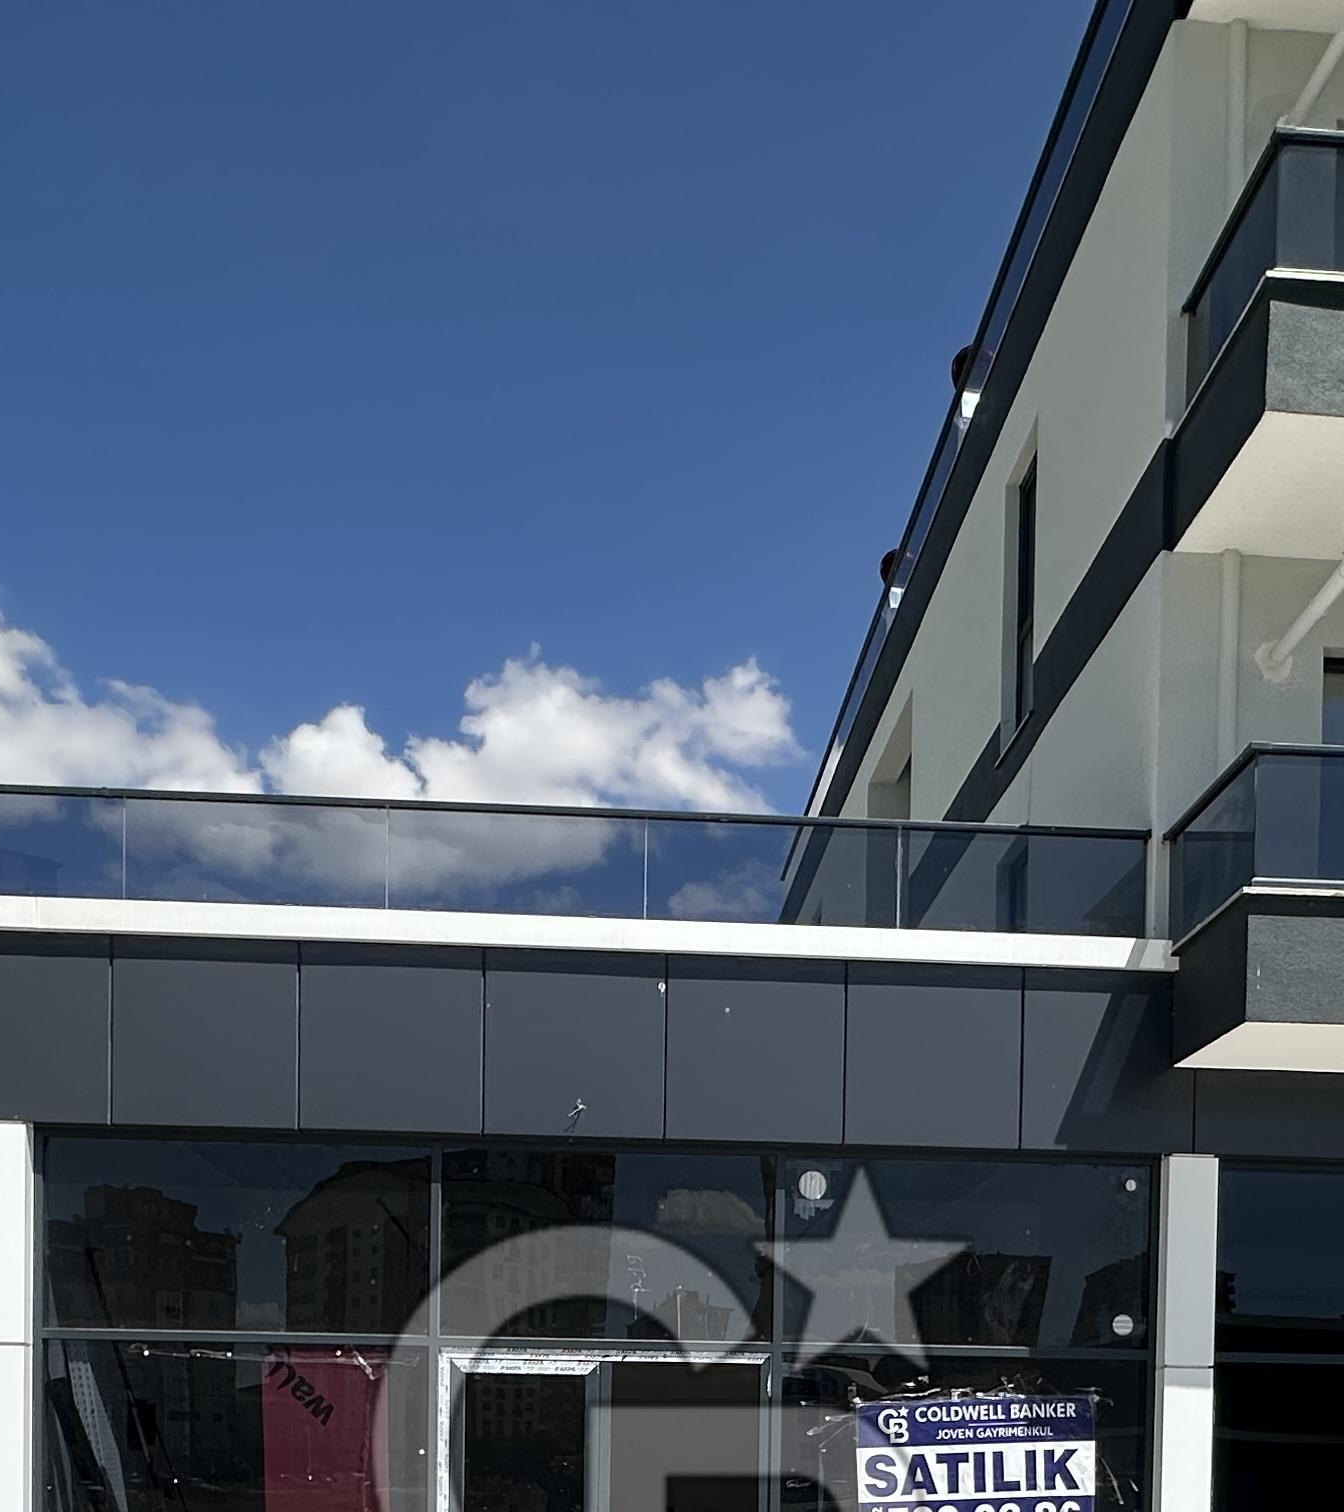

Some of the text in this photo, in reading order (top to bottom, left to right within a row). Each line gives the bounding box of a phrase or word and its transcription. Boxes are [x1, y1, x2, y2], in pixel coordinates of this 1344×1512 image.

[914, 1402, 1077, 1423] COLDWELL BANKER
[935, 1427, 974, 1440] JOVEN
[864, 1449, 1080, 1497] SATILIK
